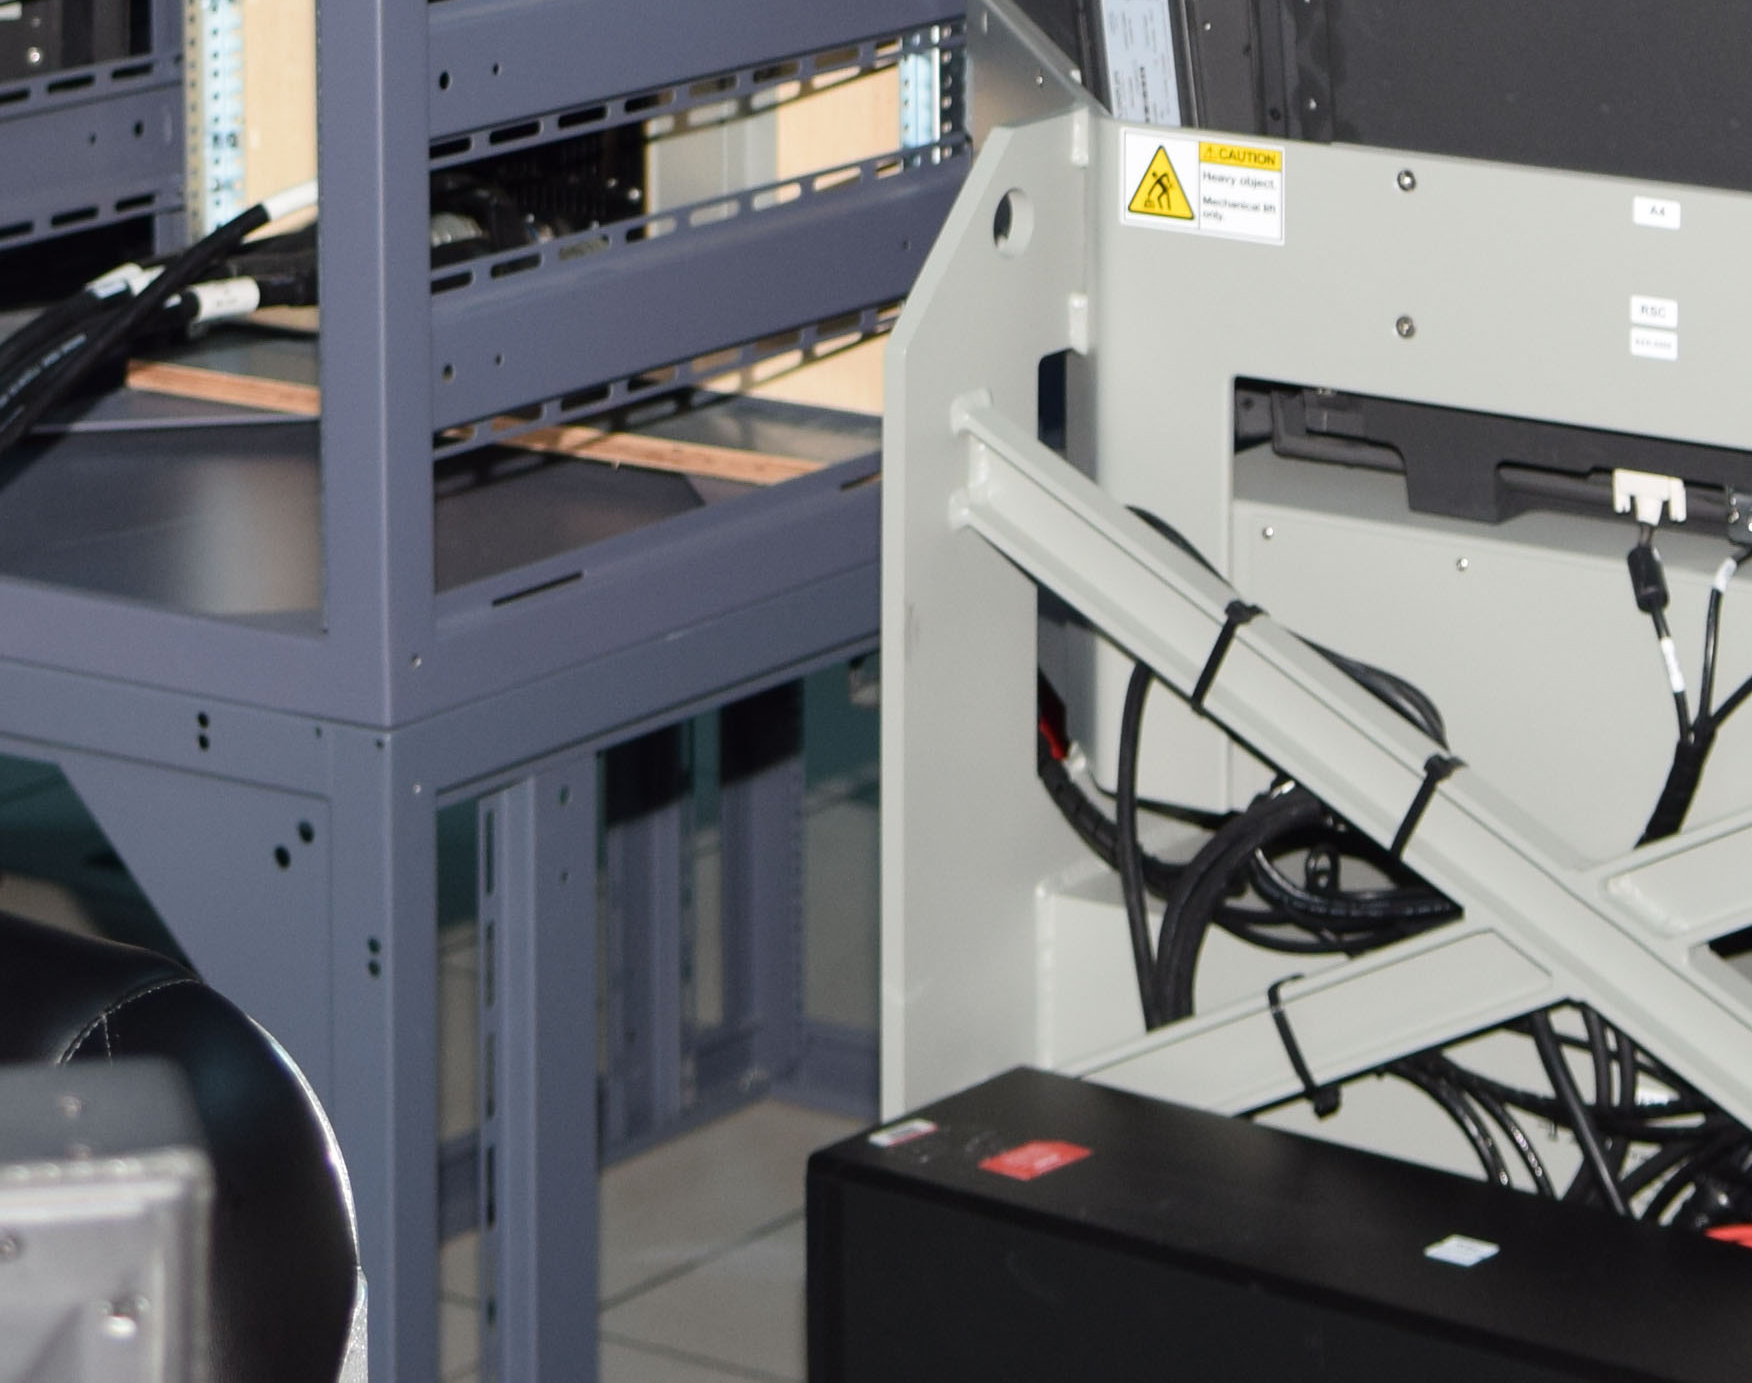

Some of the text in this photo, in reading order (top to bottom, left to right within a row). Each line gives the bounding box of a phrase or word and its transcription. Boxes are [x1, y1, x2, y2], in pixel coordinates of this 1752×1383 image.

[1219, 147, 1276, 164] CAUTION
[1202, 169, 1236, 186] Heavy
[1203, 196, 1260, 211] Mechanical
